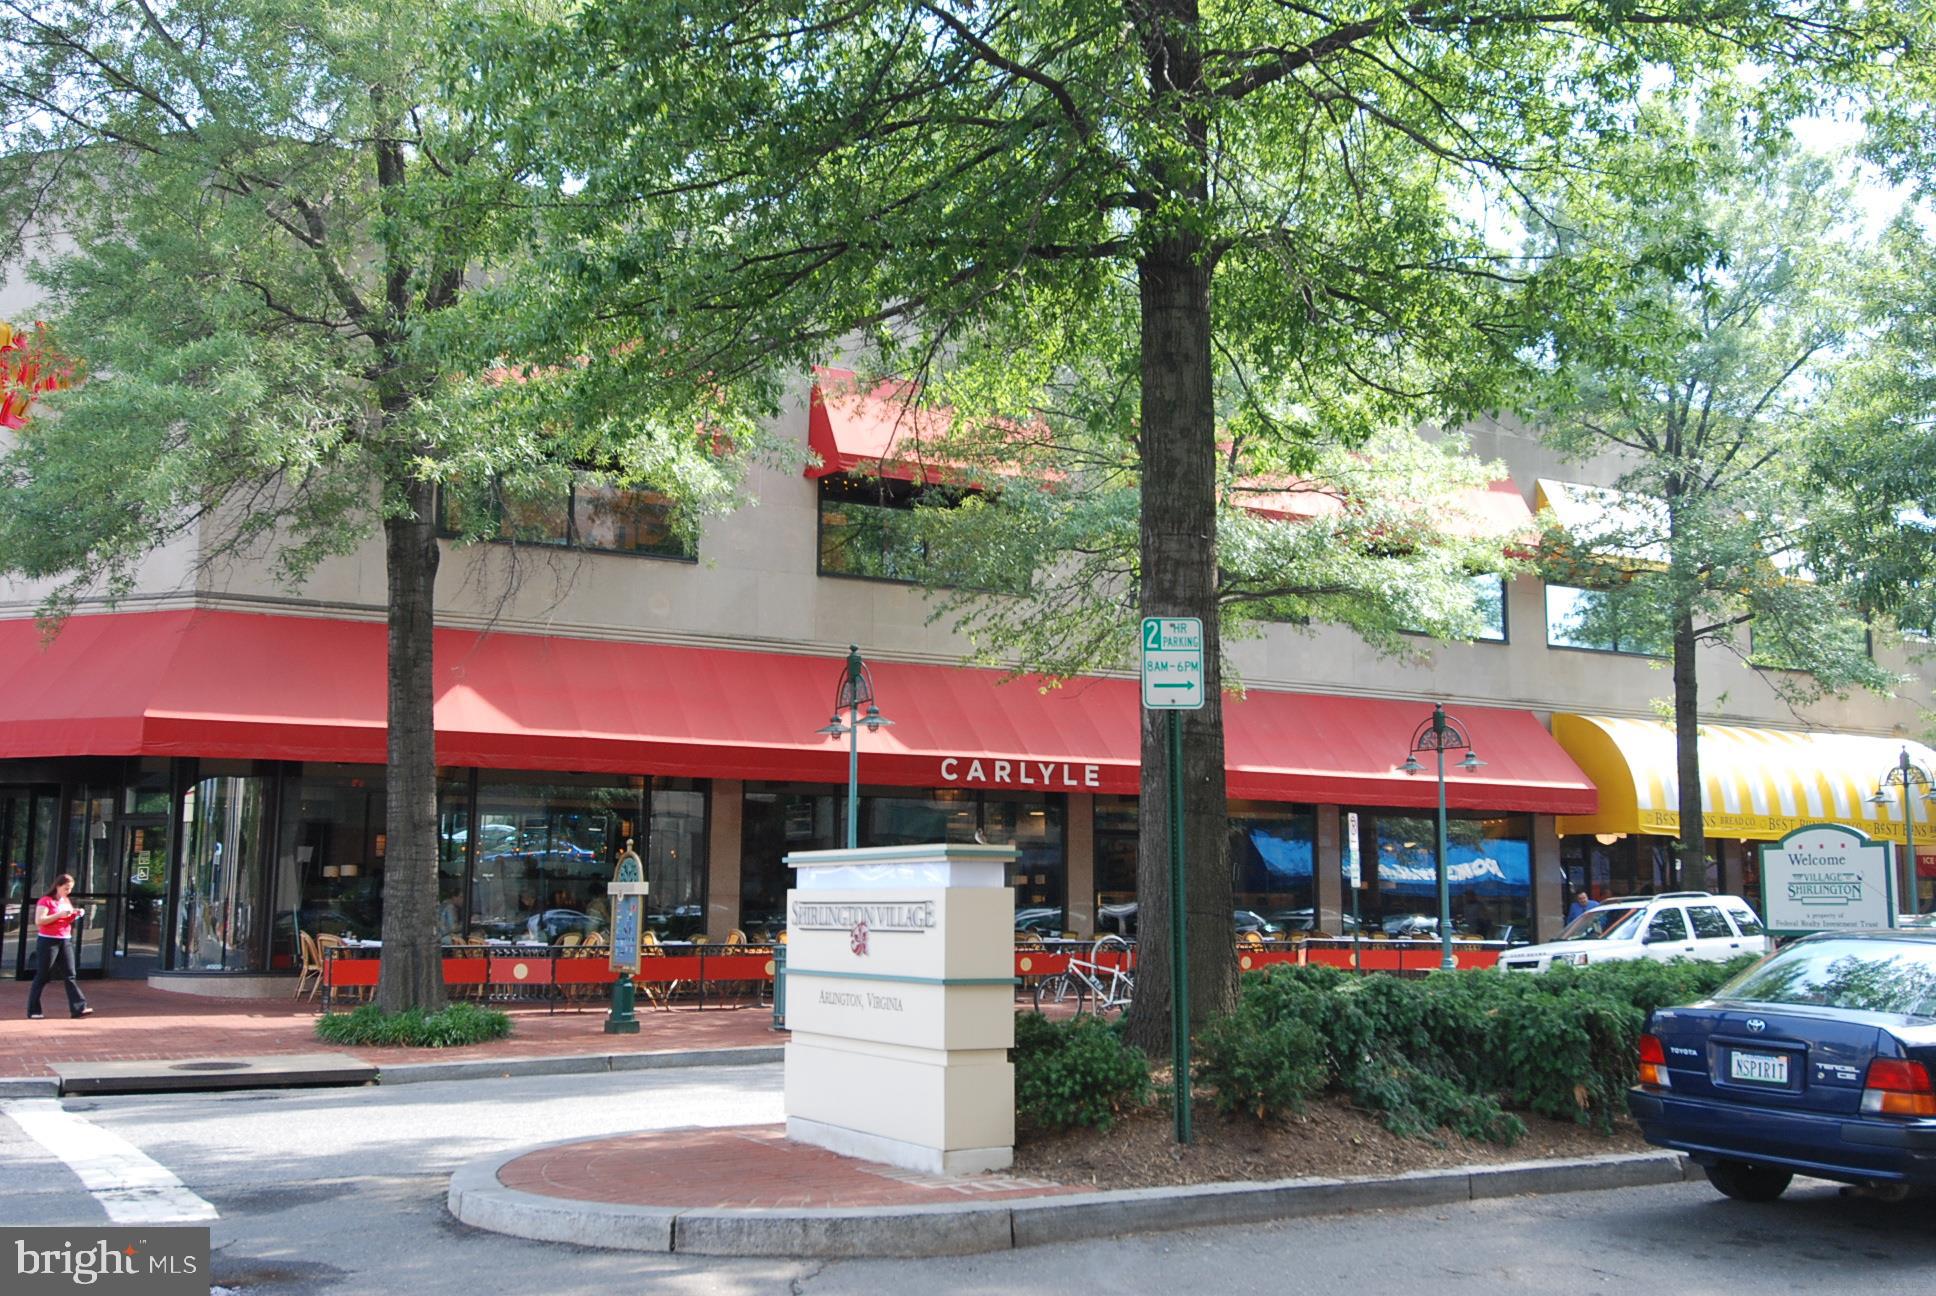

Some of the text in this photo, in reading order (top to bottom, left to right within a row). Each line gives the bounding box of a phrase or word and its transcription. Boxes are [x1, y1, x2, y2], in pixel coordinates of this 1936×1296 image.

[1147, 621, 1187, 648] 2 HR
[1163, 636, 1199, 648] PARKING
[941, 757, 1100, 787] CARLYLE
[1788, 853, 1846, 866] Welcome
[1922, 856, 1935, 865] ICE
[1803, 872, 1842, 882] VILLAGE
[1788, 884, 1862, 899] SHIRLINGTON
[791, 901, 936, 928] SHIRLINGTON VILLAGE
[1776, 919, 1799, 928] Federal
[1860, 920, 1878, 929] Trust
[867, 992, 904, 1012] VIRGINIA
[1670, 1046, 1698, 1057] TOYOTA
[1736, 1059, 1785, 1081] NSPIRIT
